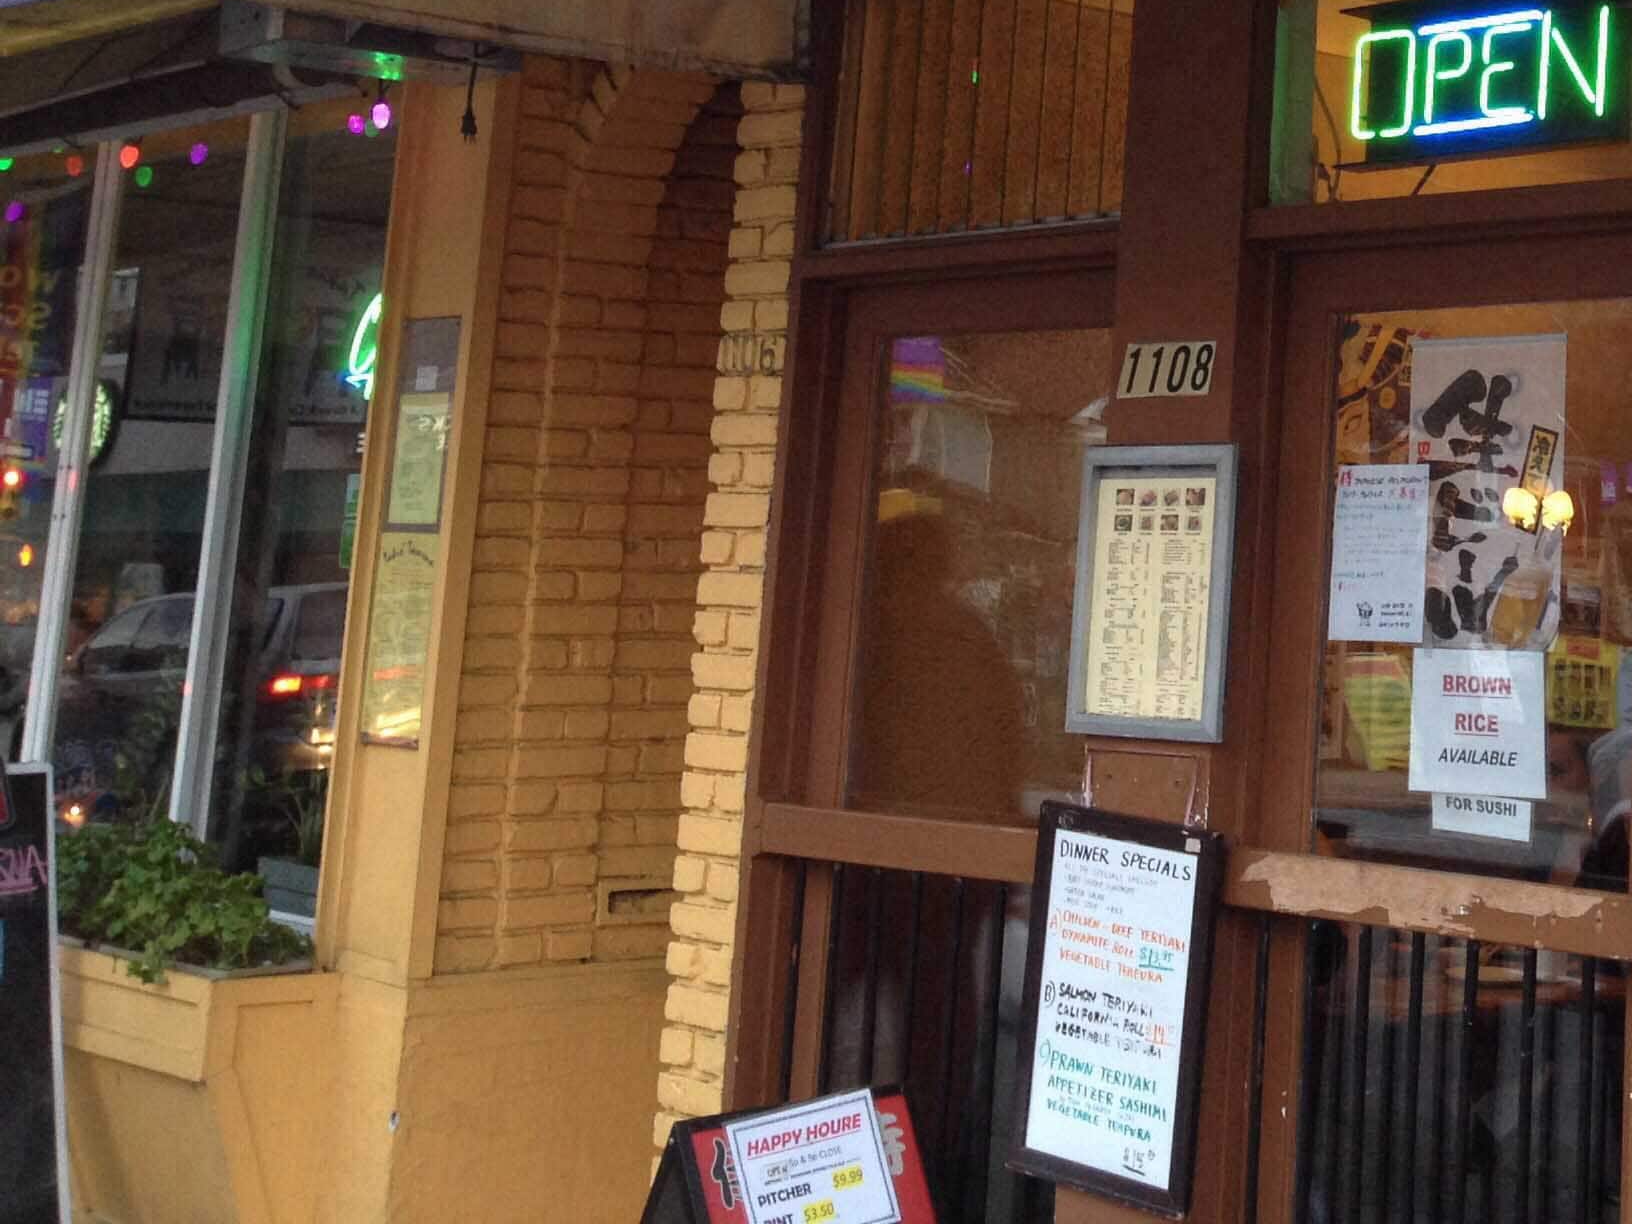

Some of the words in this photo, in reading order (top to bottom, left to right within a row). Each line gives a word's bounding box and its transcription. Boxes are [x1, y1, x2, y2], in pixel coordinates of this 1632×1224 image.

[1351, 5, 1610, 140] OPEN
[1126, 344, 1214, 394] 1108
[1443, 674, 1511, 694] BROWN
[1455, 712, 1499, 732] RICE
[1438, 747, 1518, 767] AVAILABLE
[1446, 796, 1473, 812] FOR
[1477, 799, 1517, 817] SUSHI
[1060, 839, 1109, 864] DINNER
[1121, 851, 1191, 881] SPECIALS
[1050, 1049, 1093, 1076] PRAWN
[1101, 1066, 1156, 1094] TERIYAKI
[1047, 1074, 1113, 1106] APPETIZER
[748, 1128, 802, 1156] HAPPY
[806, 1112, 861, 1140] HOURE
[757, 1183, 812, 1207] PITCHER
